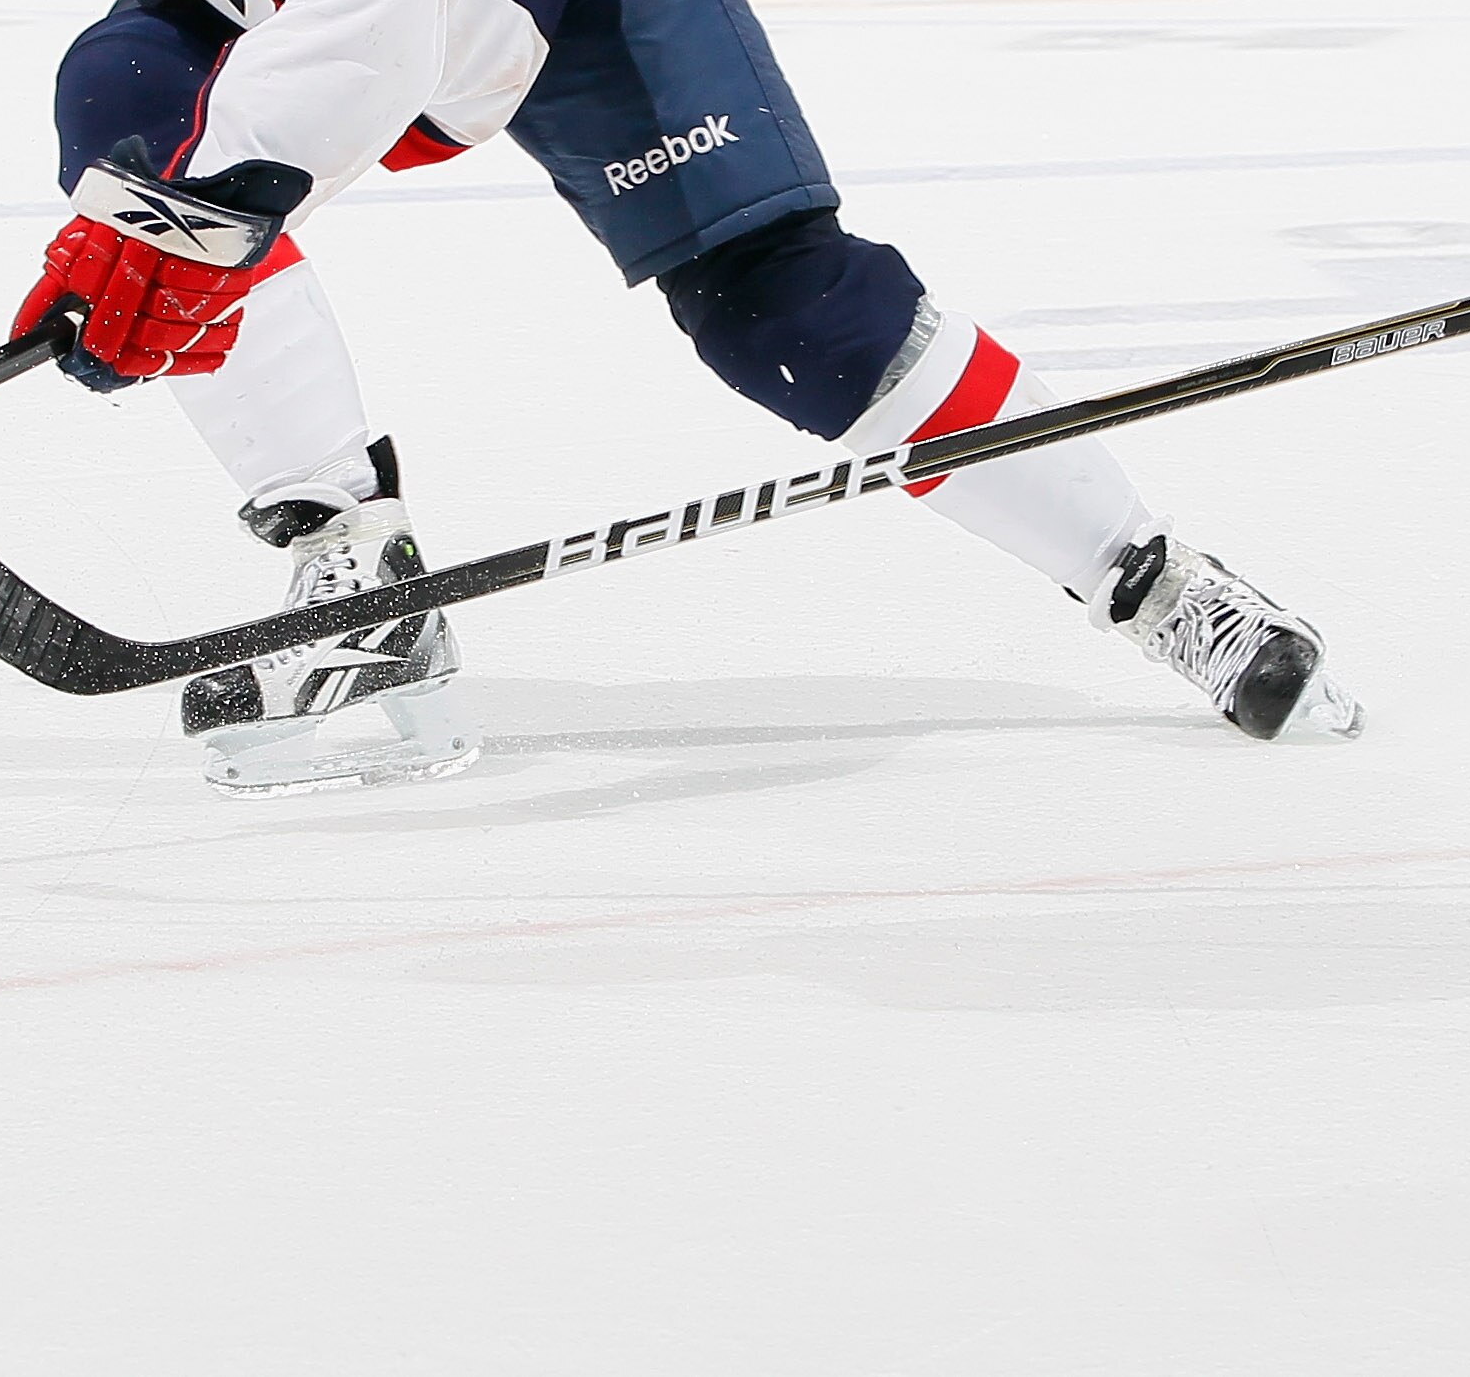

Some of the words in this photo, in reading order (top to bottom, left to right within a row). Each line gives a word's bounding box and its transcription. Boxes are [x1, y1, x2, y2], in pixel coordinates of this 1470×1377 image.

[602, 113, 740, 197] Reebok
[1330, 318, 1446, 367] BAUER
[542, 441, 915, 579] BAUER
